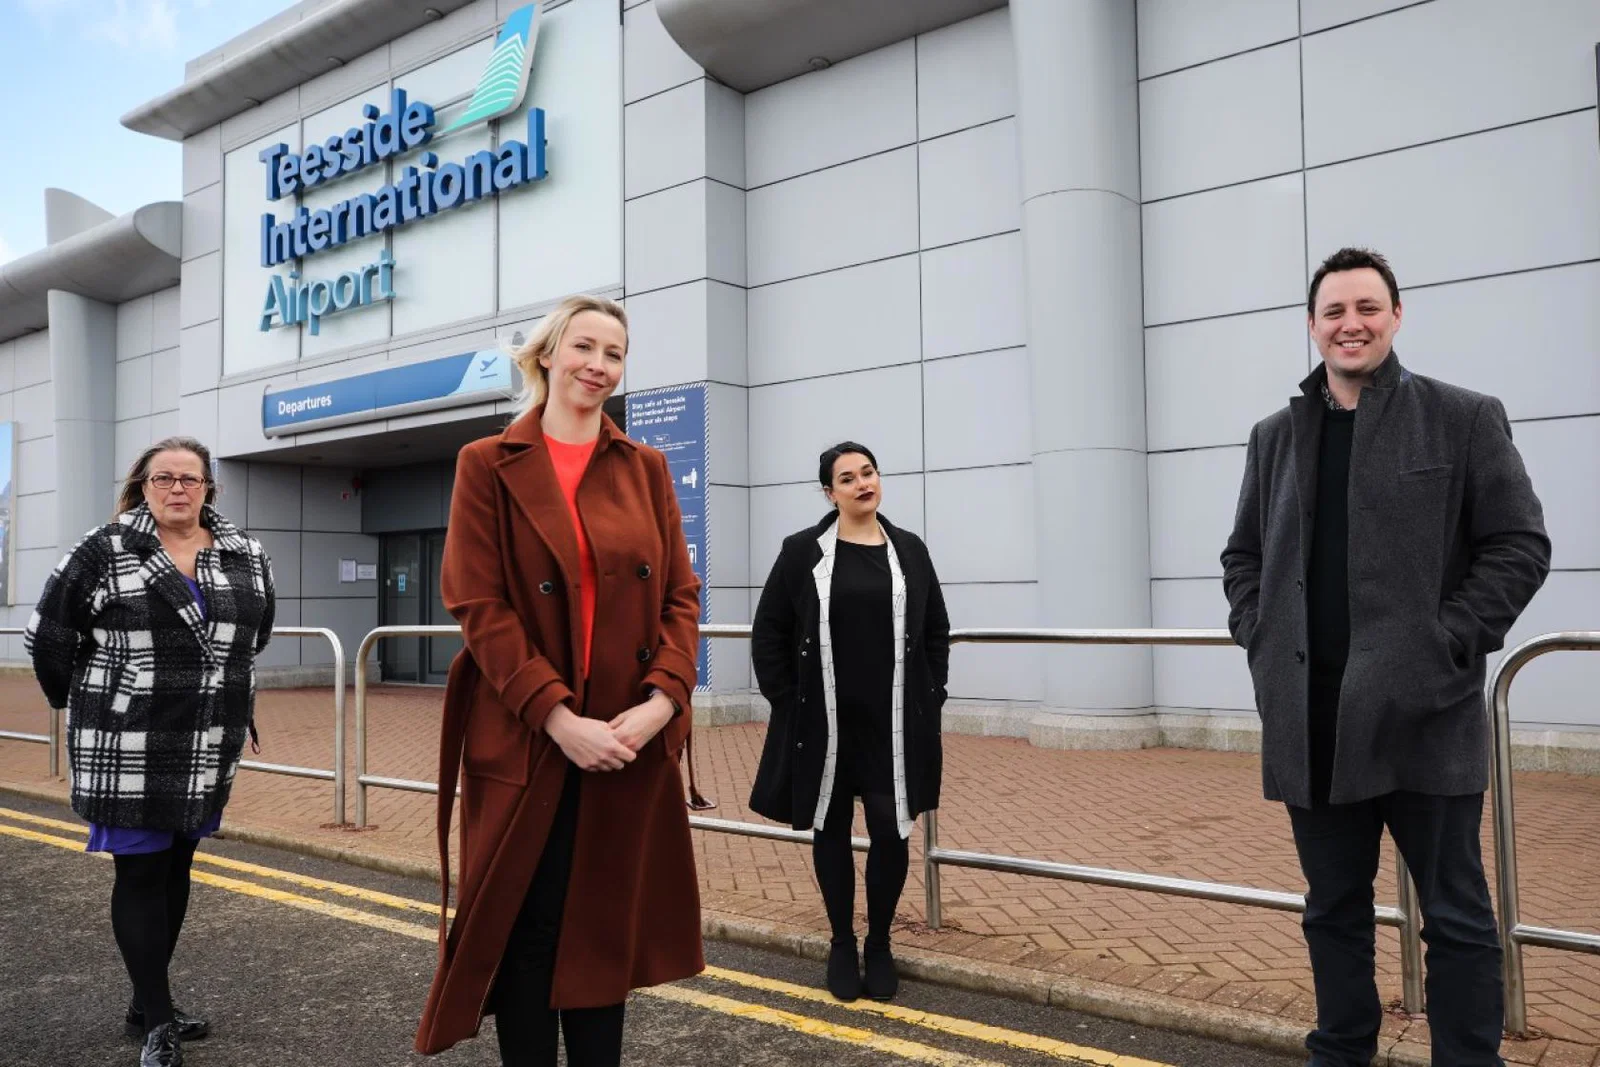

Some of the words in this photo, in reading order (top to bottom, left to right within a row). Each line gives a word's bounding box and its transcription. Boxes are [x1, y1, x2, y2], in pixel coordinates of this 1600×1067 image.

[259, 88, 435, 201] Teesside
[261, 107, 547, 268] International
[259, 250, 396, 336] Airport
[278, 394, 332, 416] Departures
[632, 403, 643, 411] Stay
[644, 400, 656, 409] safe
[663, 396, 686, 405] Teesside
[632, 408, 665, 418] International
[666, 405, 686, 413] Airport
[663, 414, 678, 423] steps
